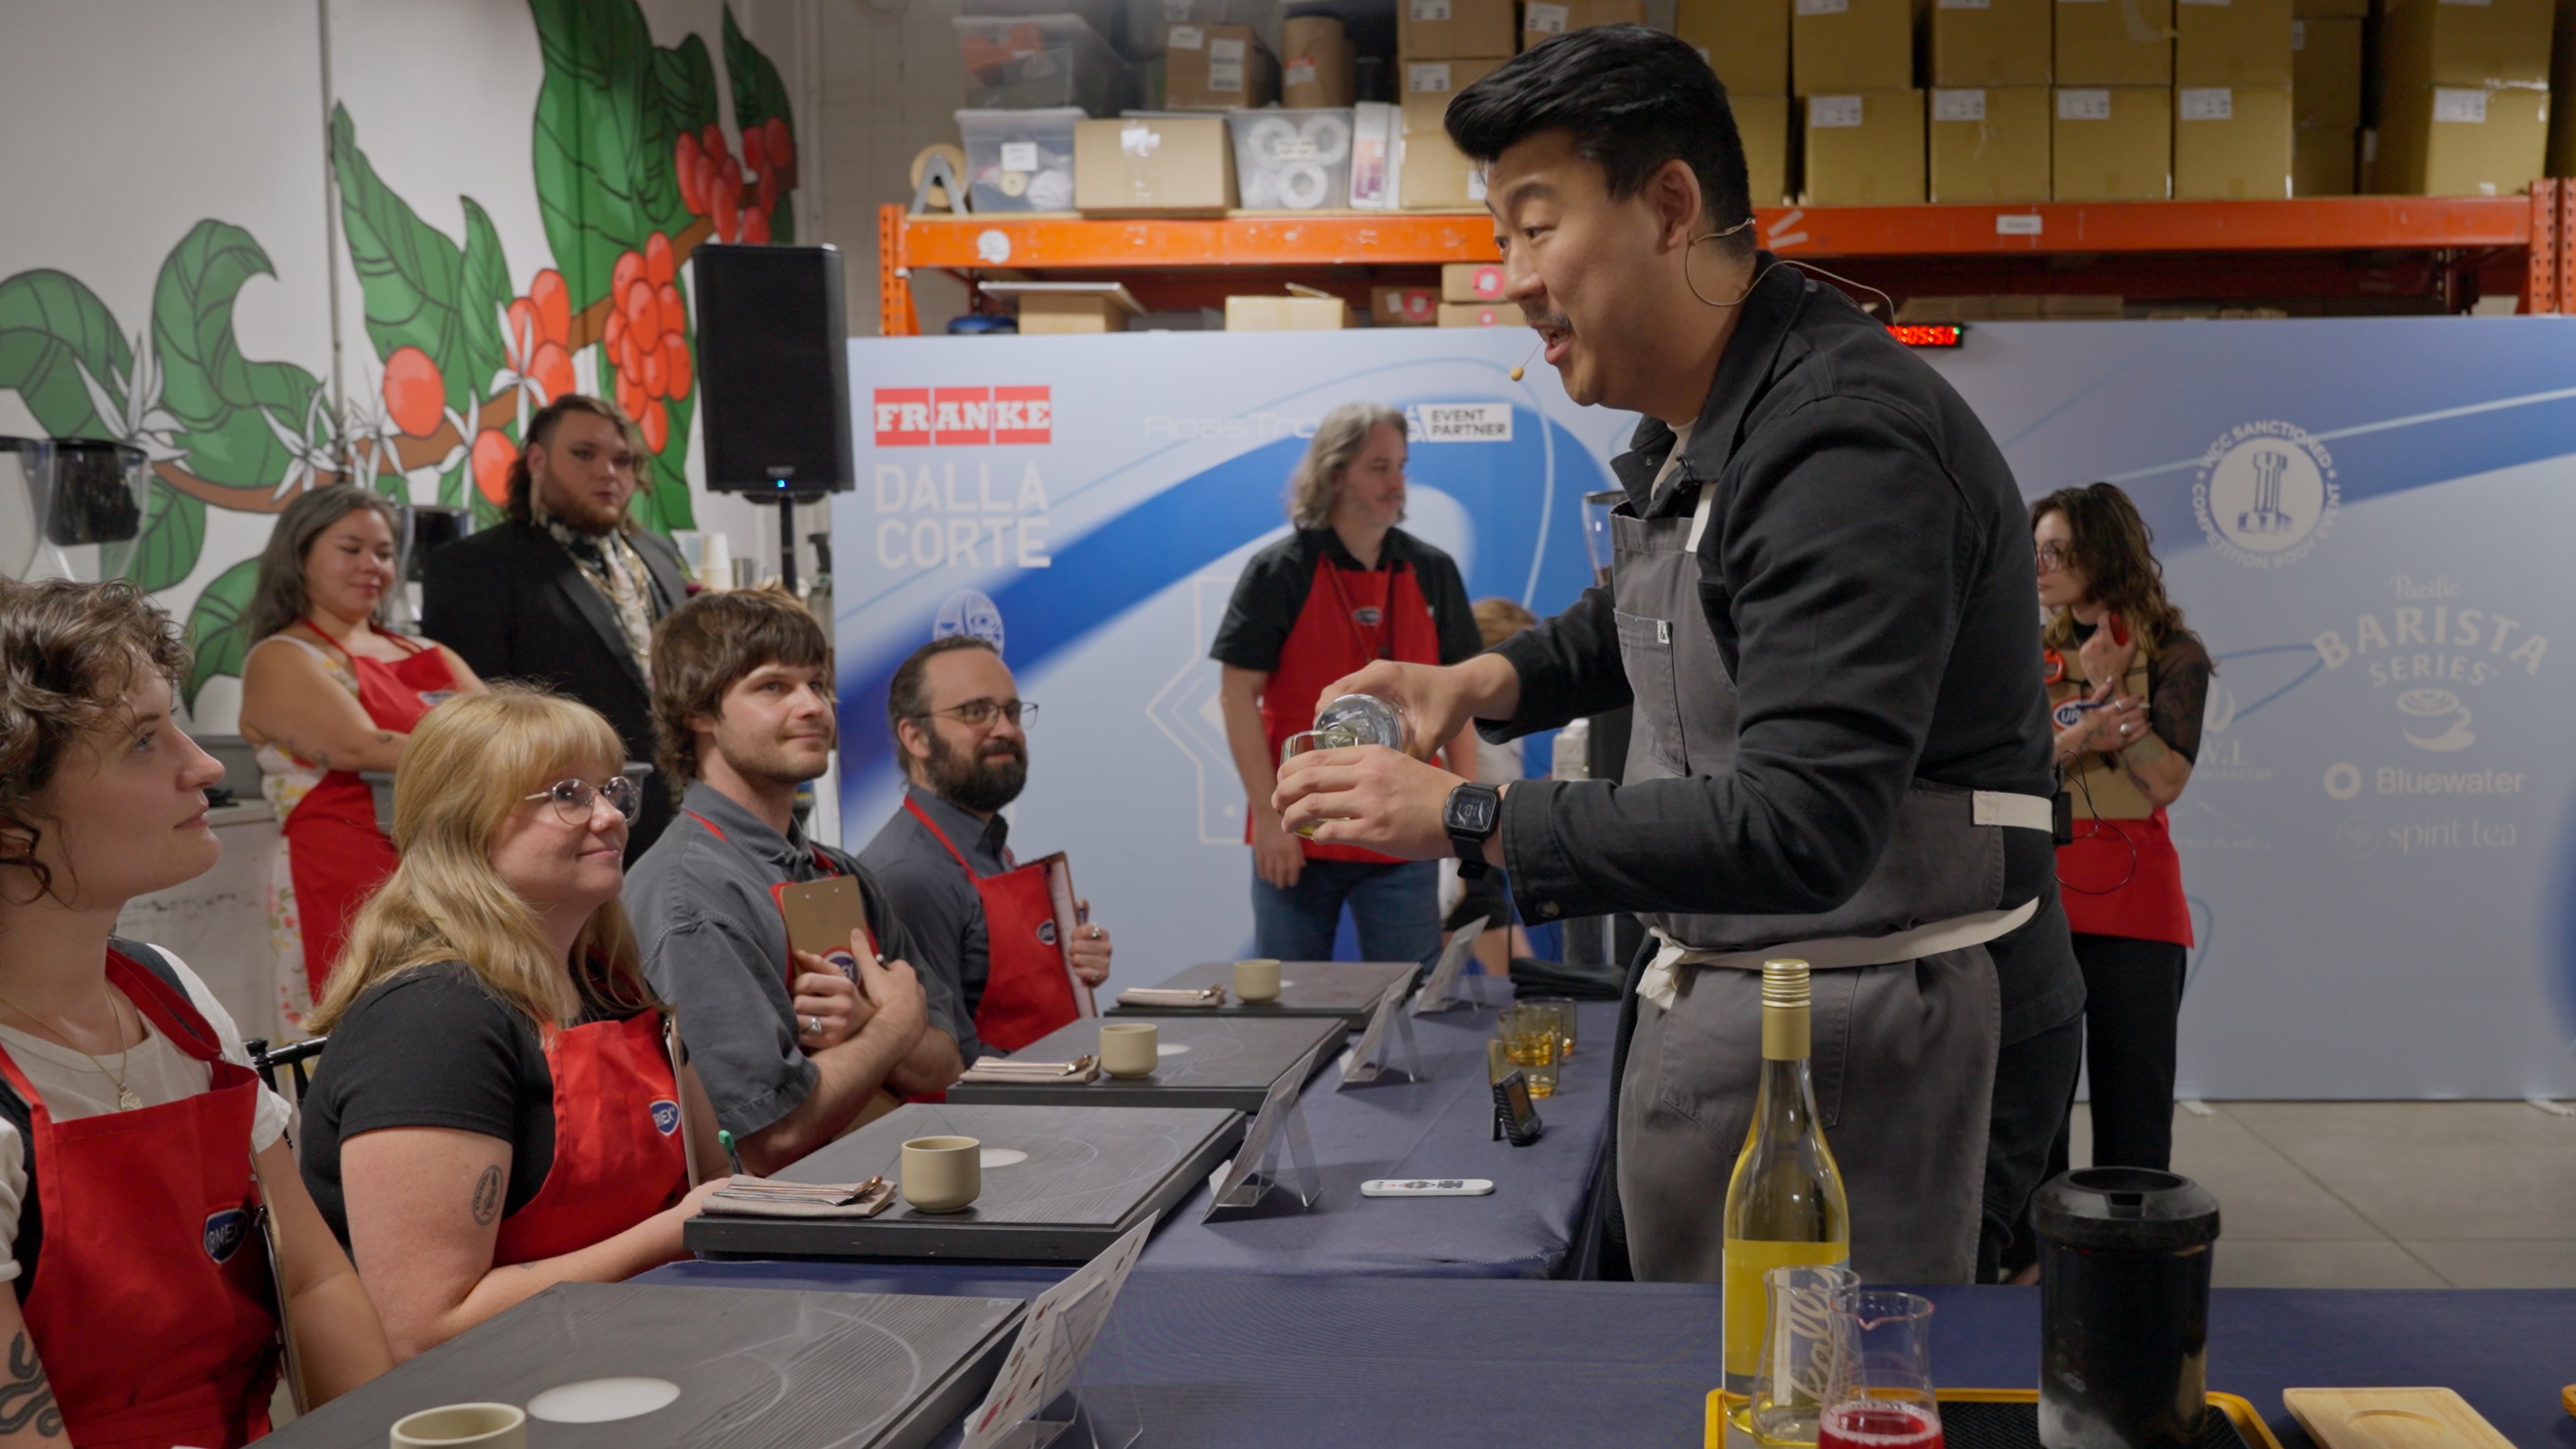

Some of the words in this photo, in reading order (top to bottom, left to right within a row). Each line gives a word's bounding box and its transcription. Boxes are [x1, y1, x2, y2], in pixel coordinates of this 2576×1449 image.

[875, 400, 1051, 431] FRANKE
[1143, 413, 1319, 439] RoasTro
[1432, 409, 1485, 422] EVENT
[1432, 423, 1506, 435] PARTNER
[2232, 419, 2332, 469] SANCTIONED
[875, 461, 1050, 513] DALLA
[2192, 482, 2268, 569] COMPETITION
[876, 517, 1052, 570] CORTE
[2388, 574, 2463, 601] Pacific
[2313, 606, 2548, 676] BARISTA
[2368, 653, 2487, 688] SERIES
[2375, 767, 2526, 795] Bluewater
[2388, 818, 2461, 855] spirit
[2472, 817, 2517, 848] tea
